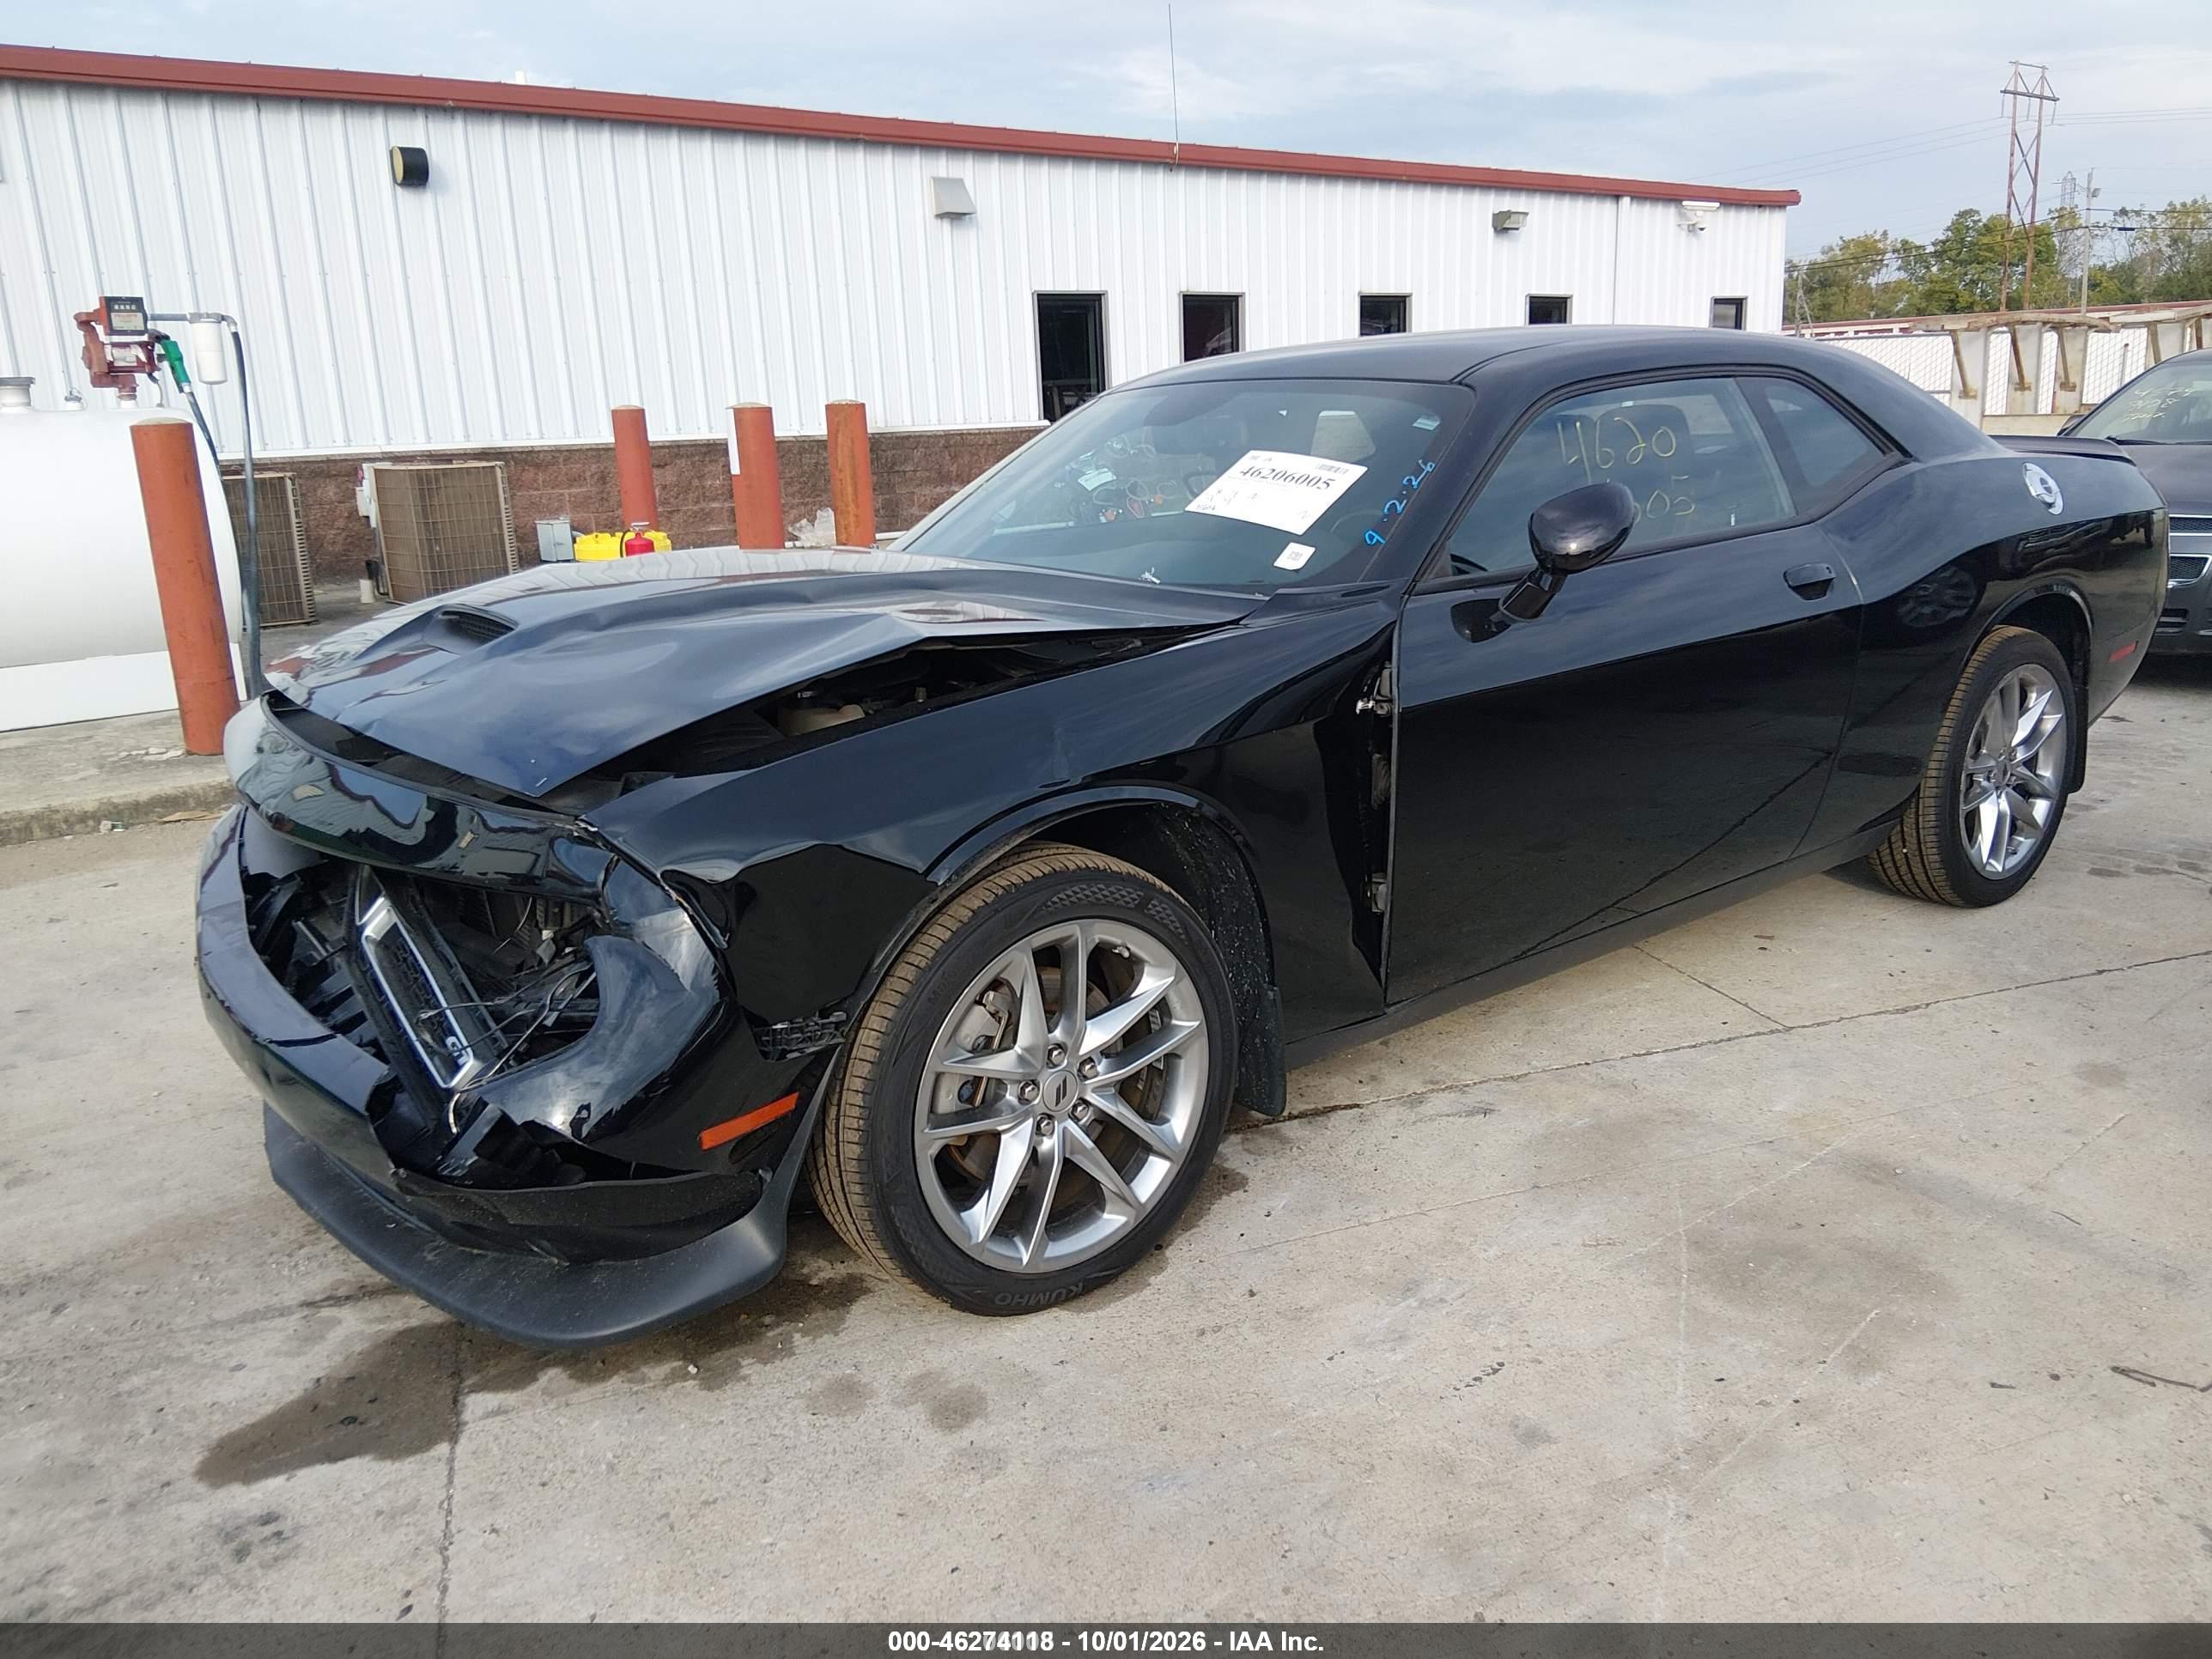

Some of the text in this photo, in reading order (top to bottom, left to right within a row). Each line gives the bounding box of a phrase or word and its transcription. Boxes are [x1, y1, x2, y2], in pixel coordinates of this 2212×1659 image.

[1557, 416, 1676, 483] 4620
[1239, 465, 1336, 490] 46206005
[994, 1282, 1085, 1306] KUMHO
